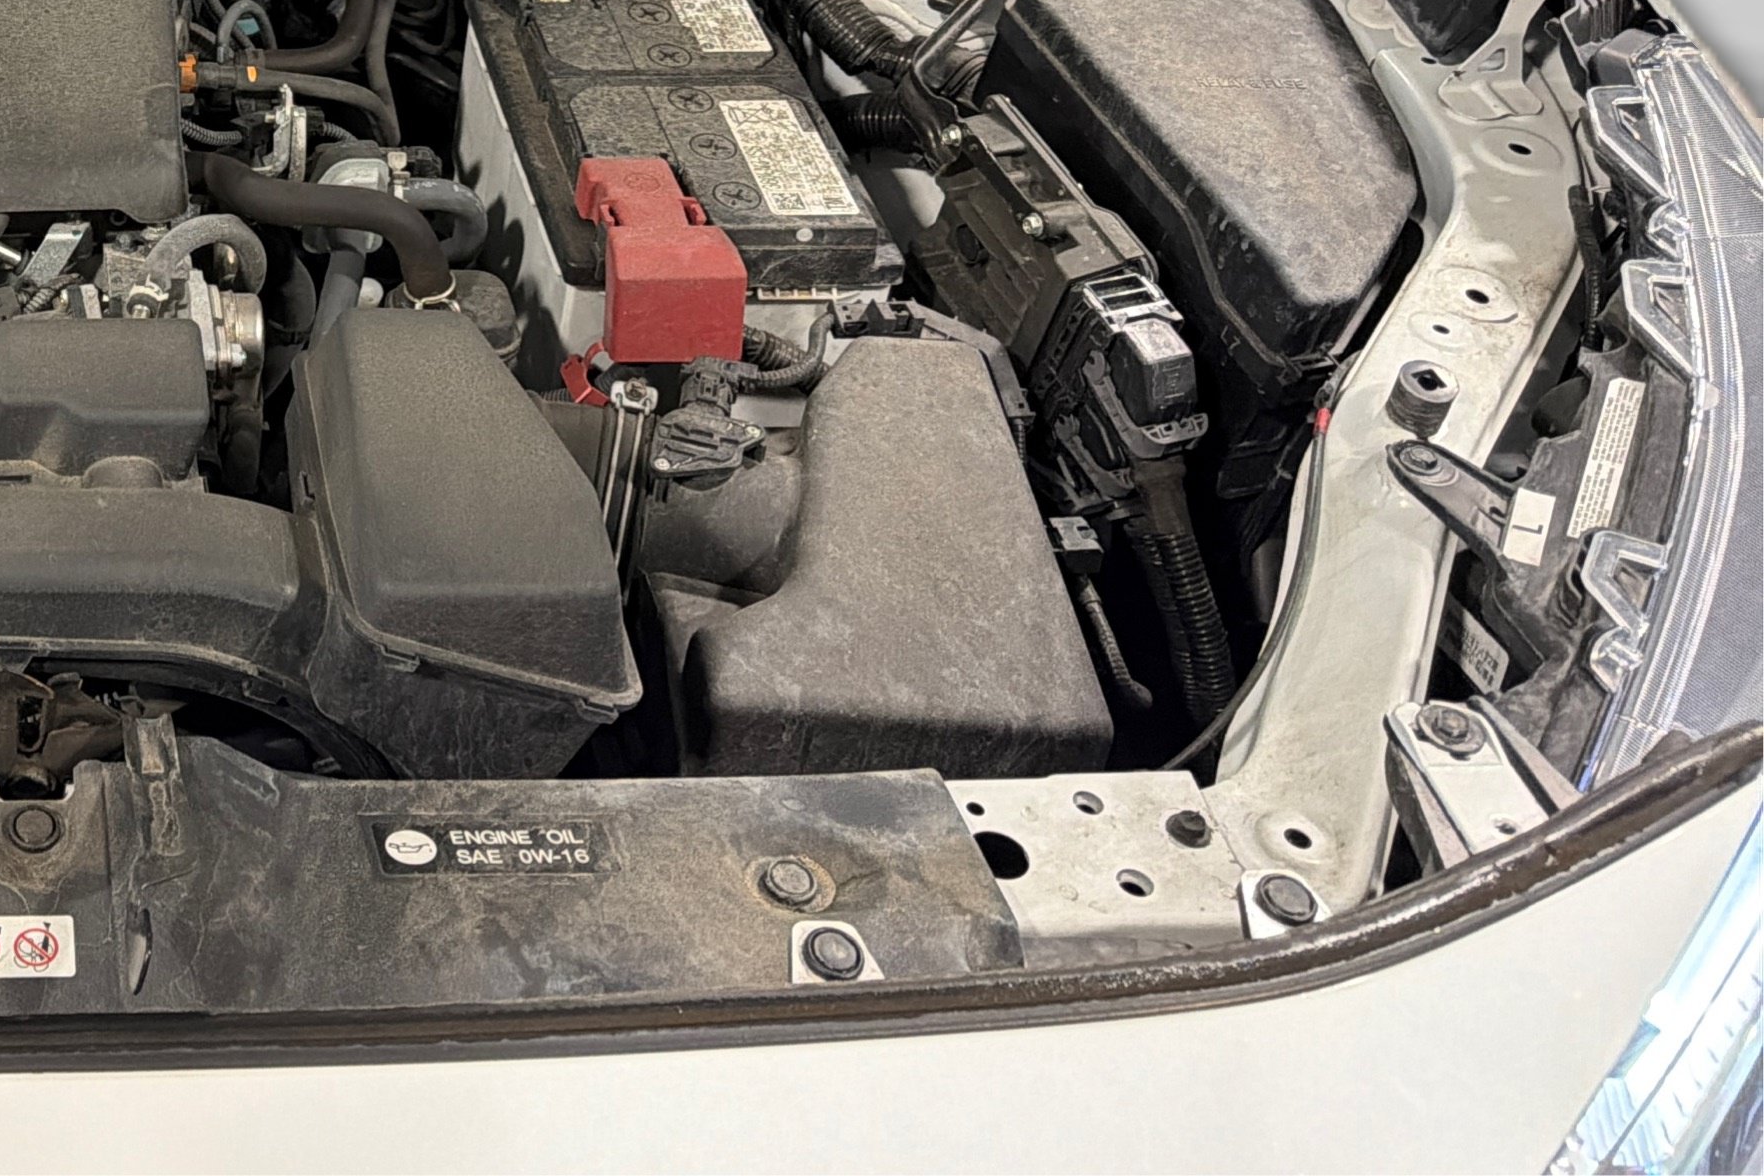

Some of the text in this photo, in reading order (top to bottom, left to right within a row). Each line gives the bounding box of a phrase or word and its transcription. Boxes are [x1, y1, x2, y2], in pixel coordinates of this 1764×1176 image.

[1195, 76, 1244, 89] RELAY
[1262, 77, 1307, 90] FUSE
[449, 829, 584, 846] ENGINE OIL
[457, 849, 590, 865] SAE 0W-16
